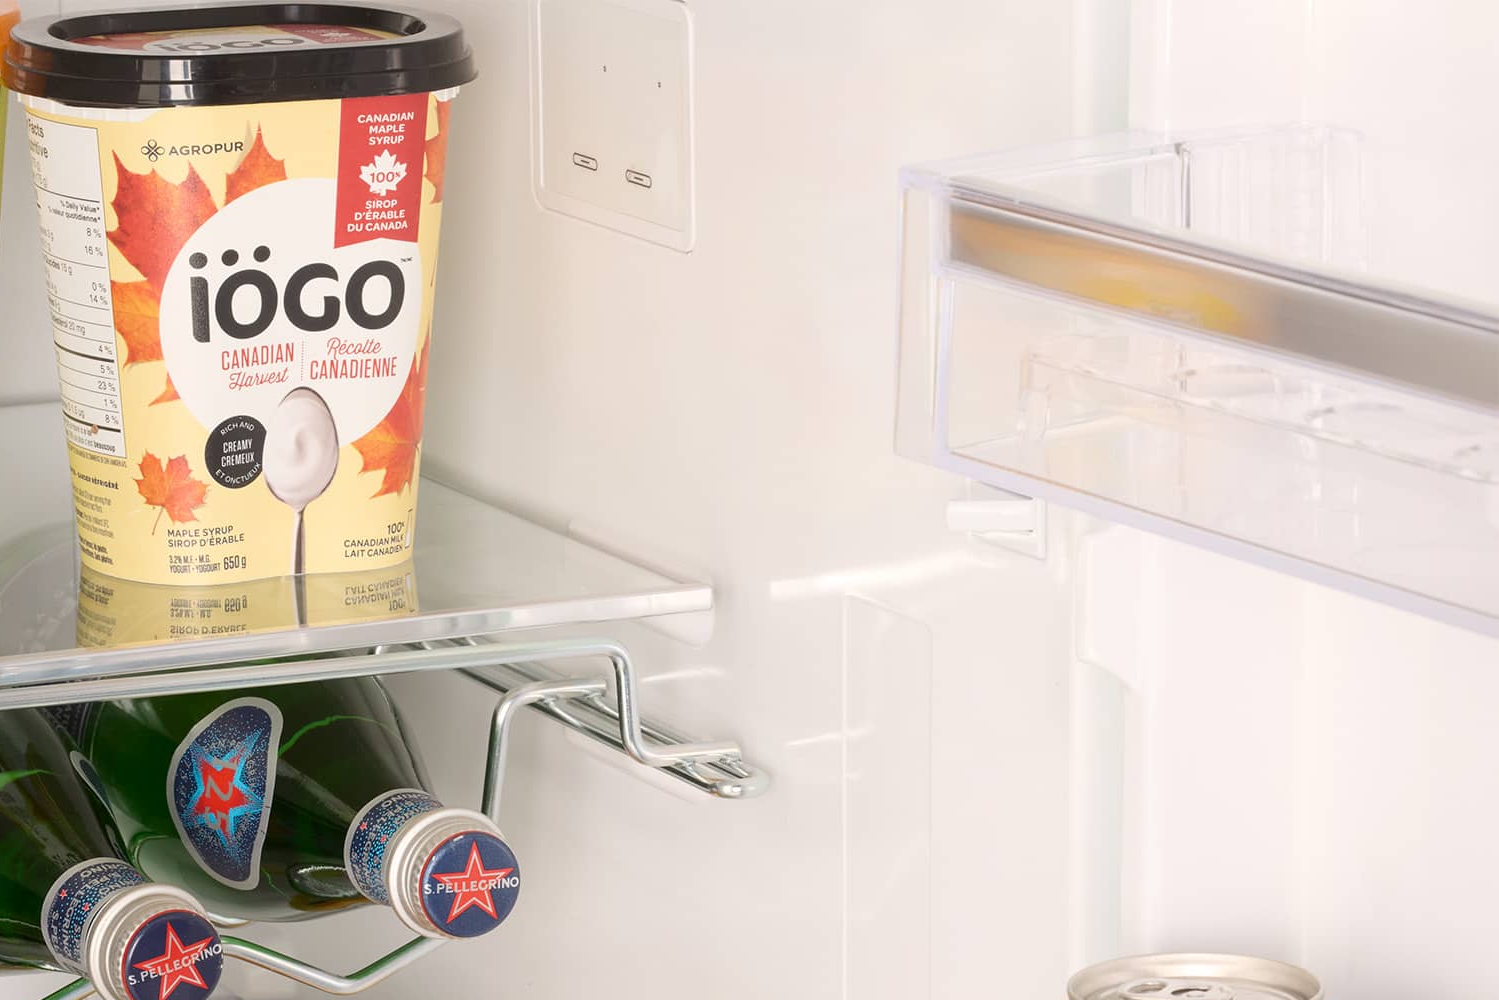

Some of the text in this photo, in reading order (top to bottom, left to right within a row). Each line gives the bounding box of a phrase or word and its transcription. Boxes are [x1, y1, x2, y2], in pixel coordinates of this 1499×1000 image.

[356, 111, 415, 124] CANADIAN
[368, 123, 406, 135] MAPLE
[368, 134, 405, 147] SYRUP
[169, 141, 244, 156] AGROPUR
[365, 198, 398, 210] SIROP
[354, 207, 406, 222] D'ÉRABLE
[347, 219, 408, 232] DU CANADA
[326, 337, 383, 358] Récolte
[221, 342, 295, 371] CANADIAN
[309, 356, 398, 381] CANADIENNE
[229, 368, 289, 392] Harvest
[220, 421, 255, 436] RICH AND
[223, 439, 253, 453] CREAMY
[225, 462, 261, 484] ONCTUEUX
[167, 525, 234, 539] MAPLE SYRUP
[168, 533, 245, 549] SIROP D'ÉRABLE
[343, 537, 389, 549] CANADIAN
[344, 545, 403, 558] LAIT CANADIEN
[169, 562, 221, 573] YOGURT YOGOURT
[223, 555, 239, 571] 650
